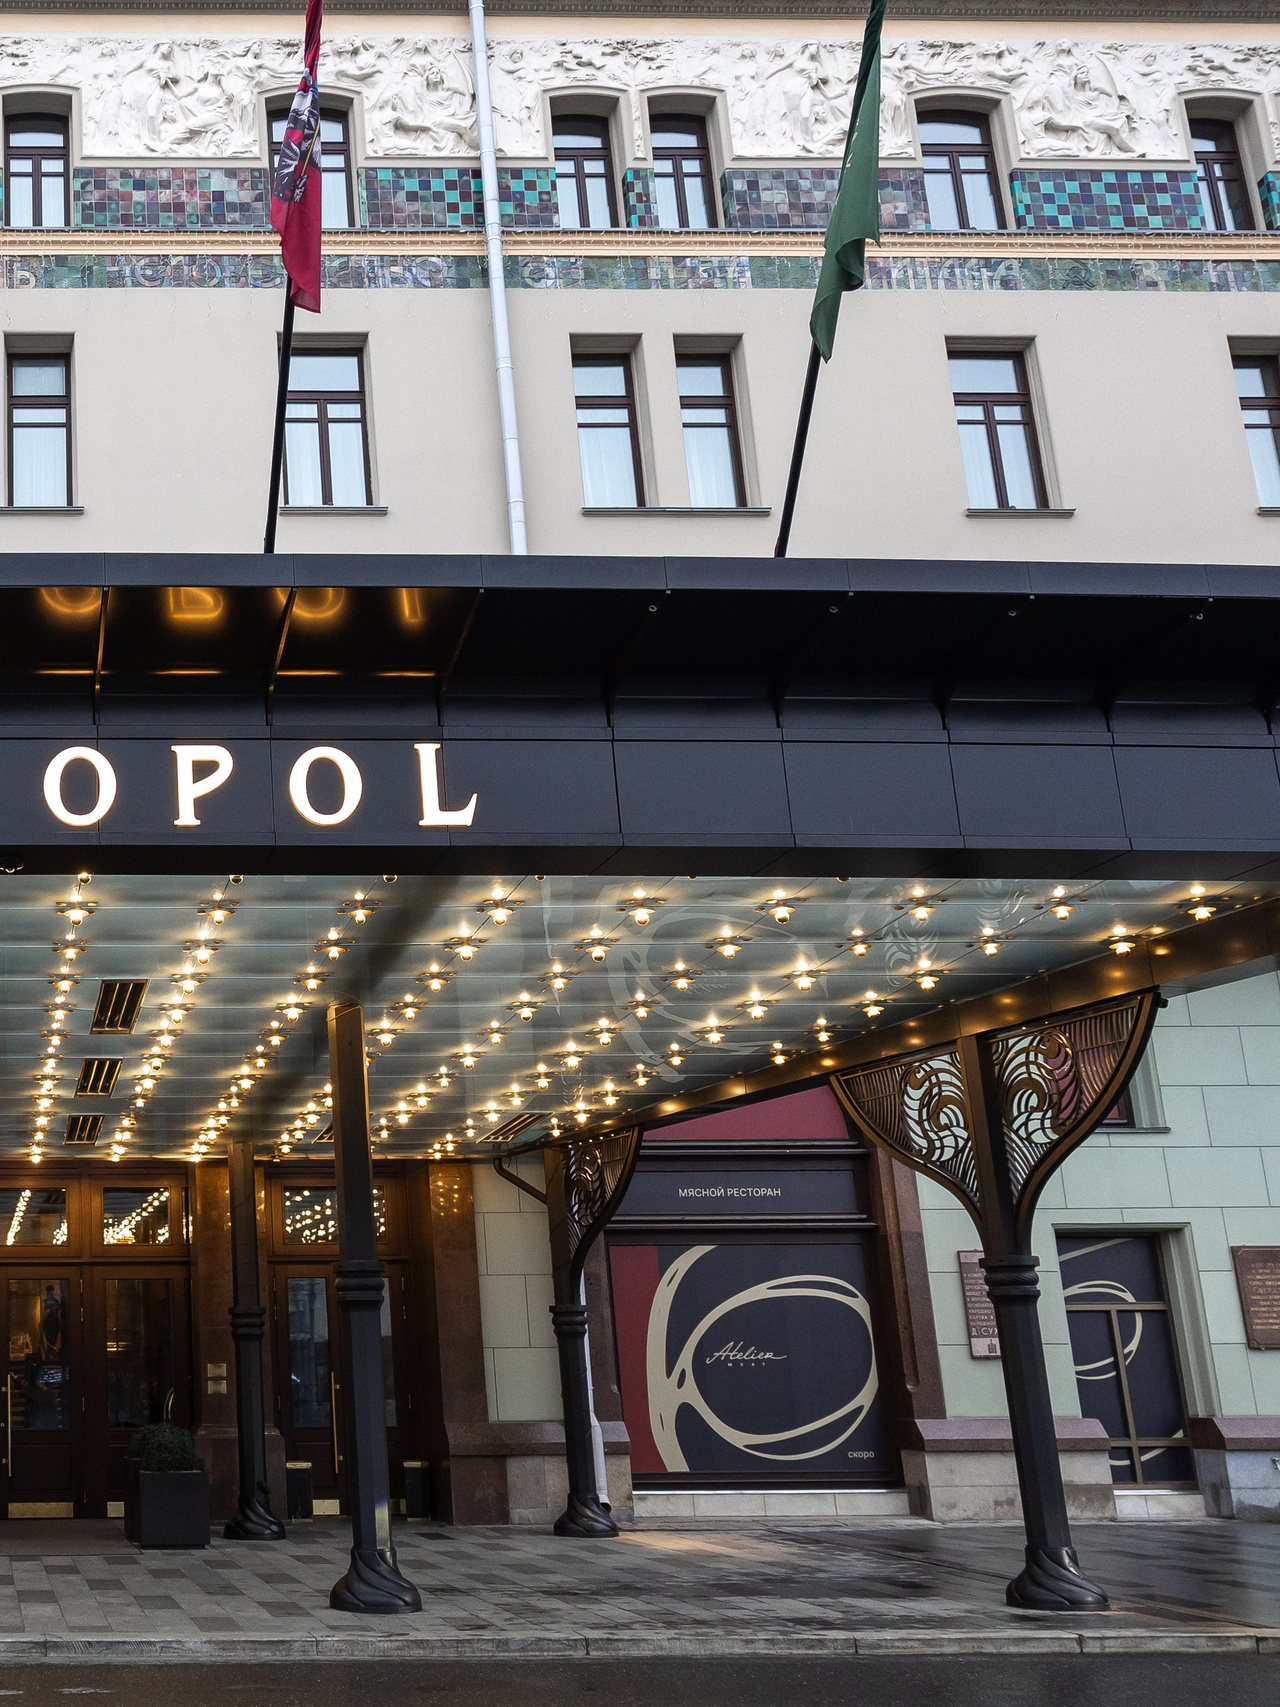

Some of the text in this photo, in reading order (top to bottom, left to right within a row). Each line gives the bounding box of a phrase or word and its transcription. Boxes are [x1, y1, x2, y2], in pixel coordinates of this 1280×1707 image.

[678, 1186, 781, 1197] МЯСНОЙ РЕСТОРАН
[706, 1341, 788, 1365] Atelier
[848, 1451, 875, 1460] скоро
